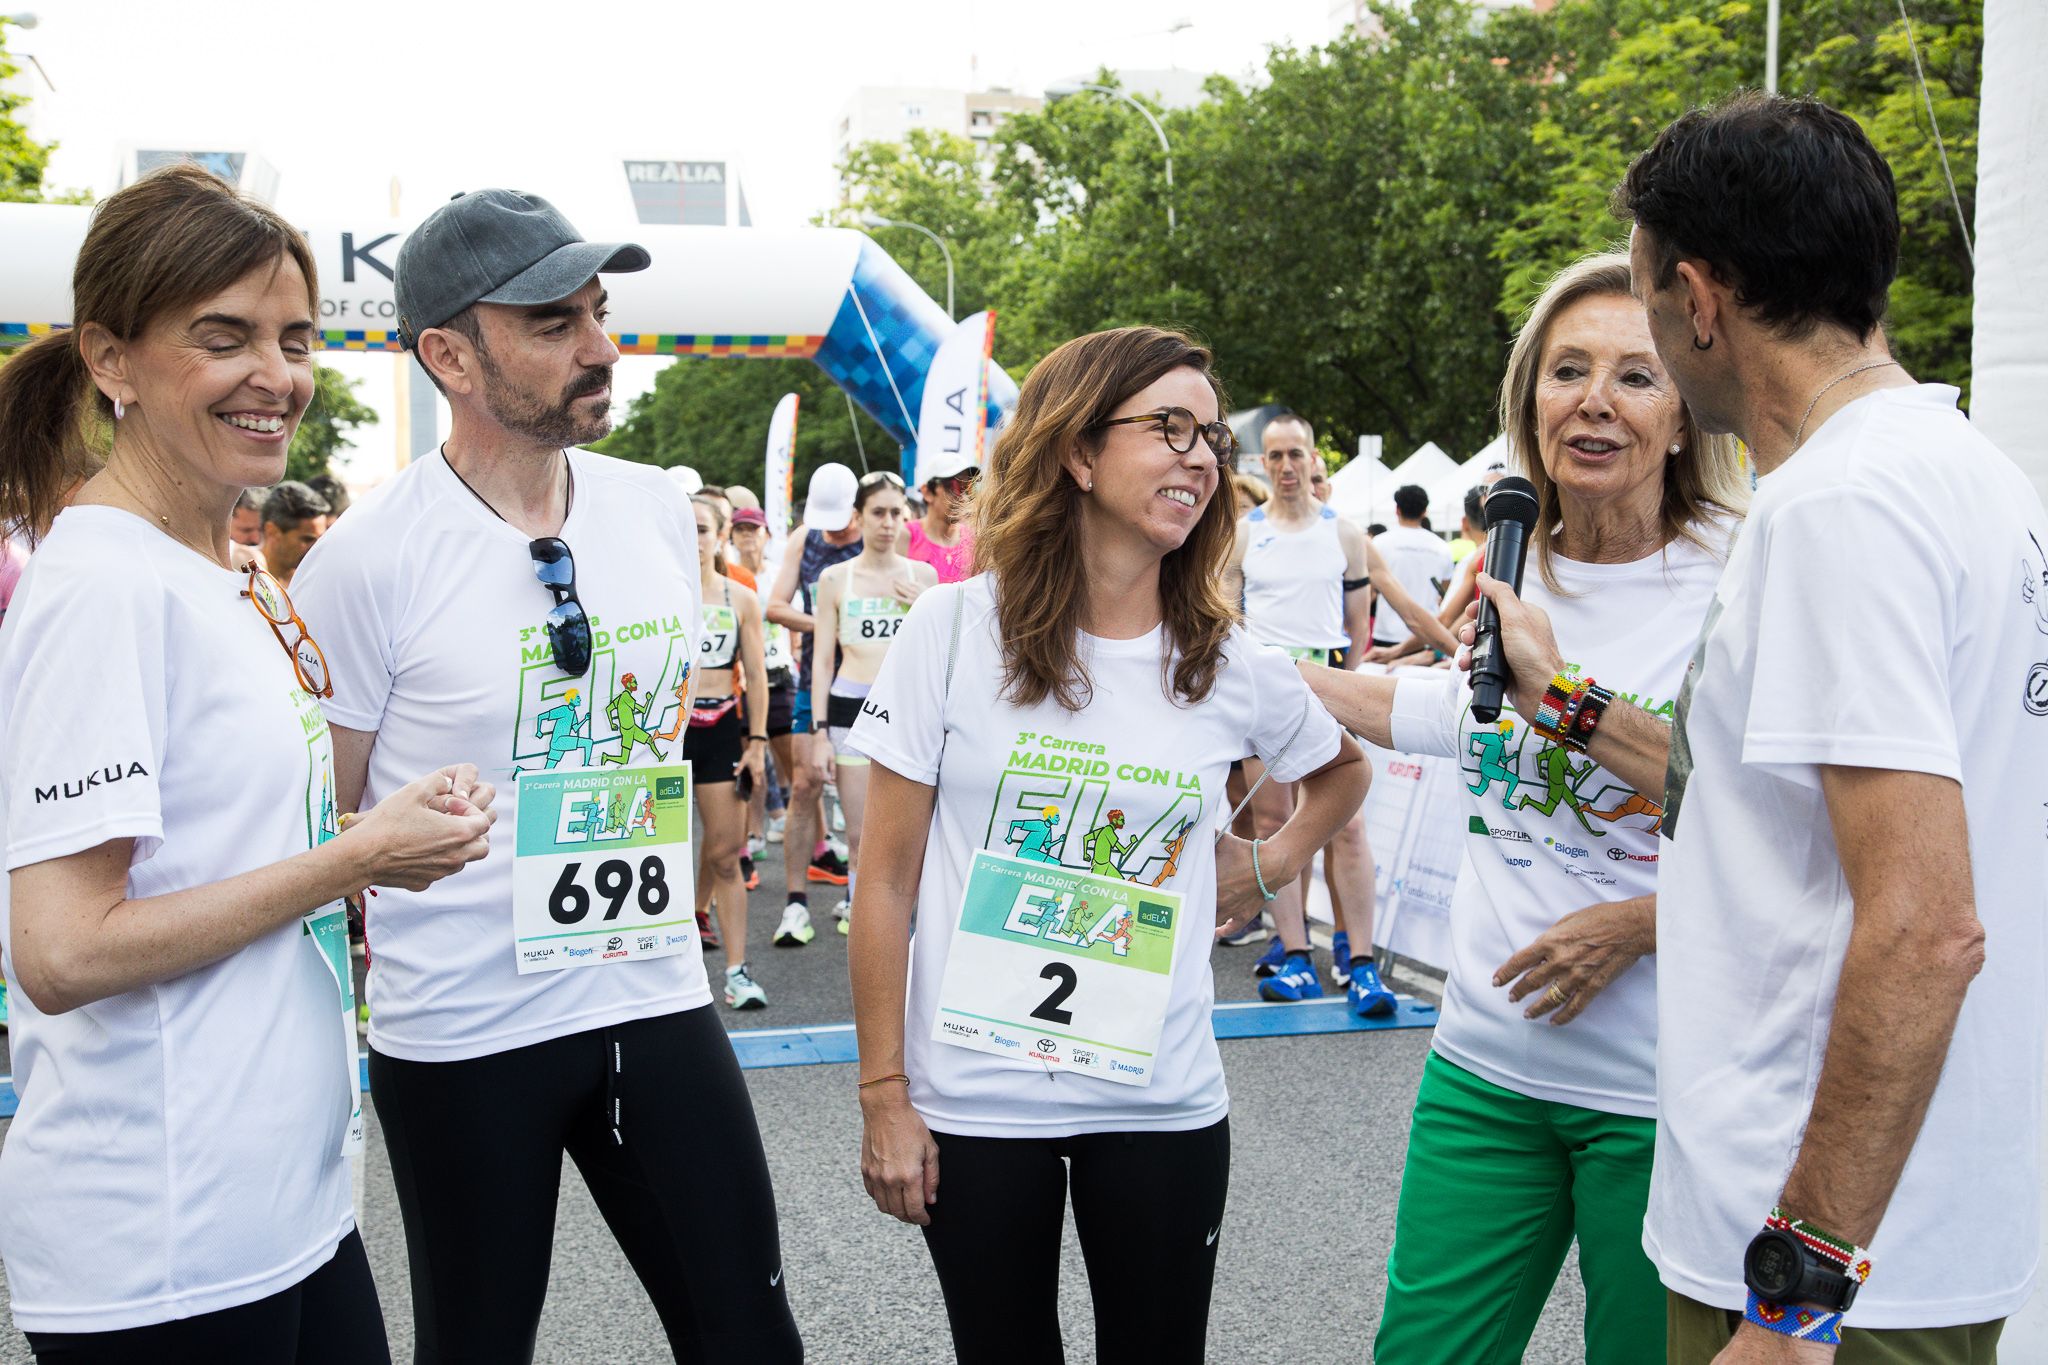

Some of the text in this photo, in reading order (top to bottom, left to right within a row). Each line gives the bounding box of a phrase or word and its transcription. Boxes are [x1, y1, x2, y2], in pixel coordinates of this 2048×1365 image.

[320, 300, 348, 316] OF
[616, 620, 659, 643] CON
[662, 615, 682, 634] LA
[1643, 698, 1675, 719] LA
[1016, 732, 1106, 755] 3ª Carrera
[1007, 751, 1201, 791] MADRID CON LA
[35, 761, 149, 803] MUKUA
[533, 782, 560, 790] Carrera
[563, 777, 609, 790] MADRID
[612, 775, 632, 786] CON
[634, 774, 647, 785] LA
[660, 786, 680, 796] adELA
[554, 786, 657, 845] ELA
[1555, 842, 1589, 858] Biogen
[549, 855, 669, 924] 698
[990, 864, 1021, 878] Carrera
[1024, 870, 1081, 889] MADRID
[1081, 884, 1109, 899] CON
[1112, 890, 1128, 902] LA
[1002, 883, 1128, 957] ELA
[1142, 912, 1167, 925] adELA
[637, 936, 655, 944] SPORT
[640, 942, 653, 950] LIFE
[671, 935, 688, 943] MADRID
[523, 949, 555, 958] MUKUA
[569, 947, 593, 957] Biogen
[1030, 962, 1078, 1025] 2
[944, 1022, 979, 1035] MUKUA
[994, 1035, 1020, 1048] Biogen
[1073, 1048, 1094, 1058] SPORT
[1073, 1056, 1090, 1065] LIFE
[1118, 1064, 1144, 1075] MADRID
